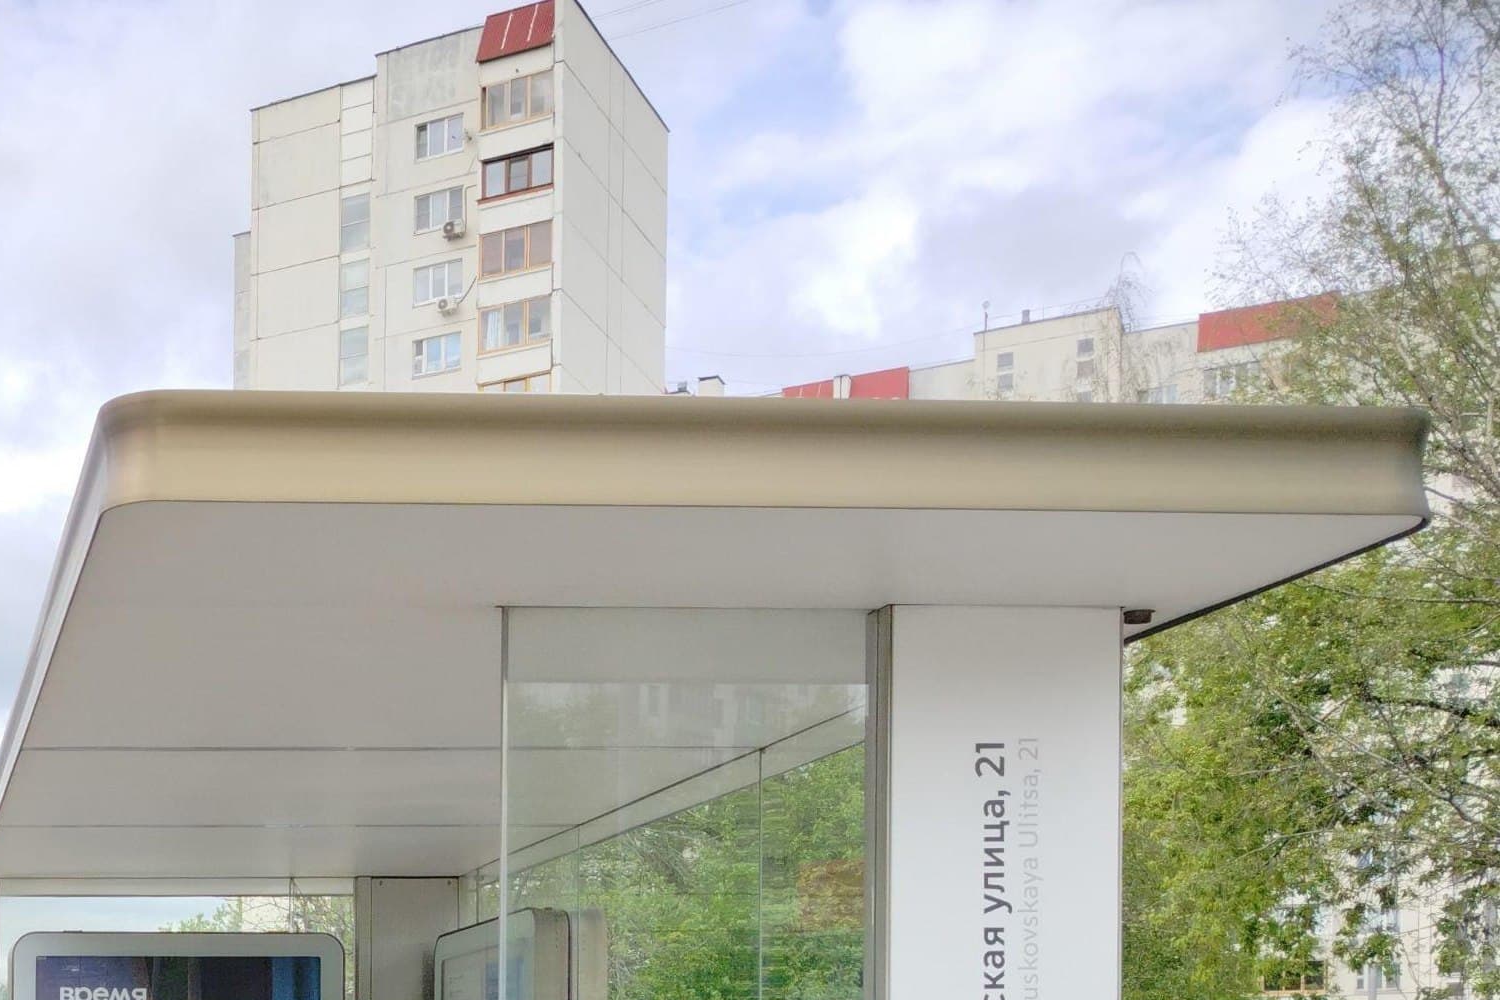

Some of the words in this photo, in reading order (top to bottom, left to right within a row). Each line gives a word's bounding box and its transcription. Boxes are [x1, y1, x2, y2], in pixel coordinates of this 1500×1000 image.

[975, 742, 1005, 778] 21
[1018, 737, 1039, 761] 21
[1017, 769, 1042, 848] Ulitsa,
[983, 790, 1013, 915] улица,
